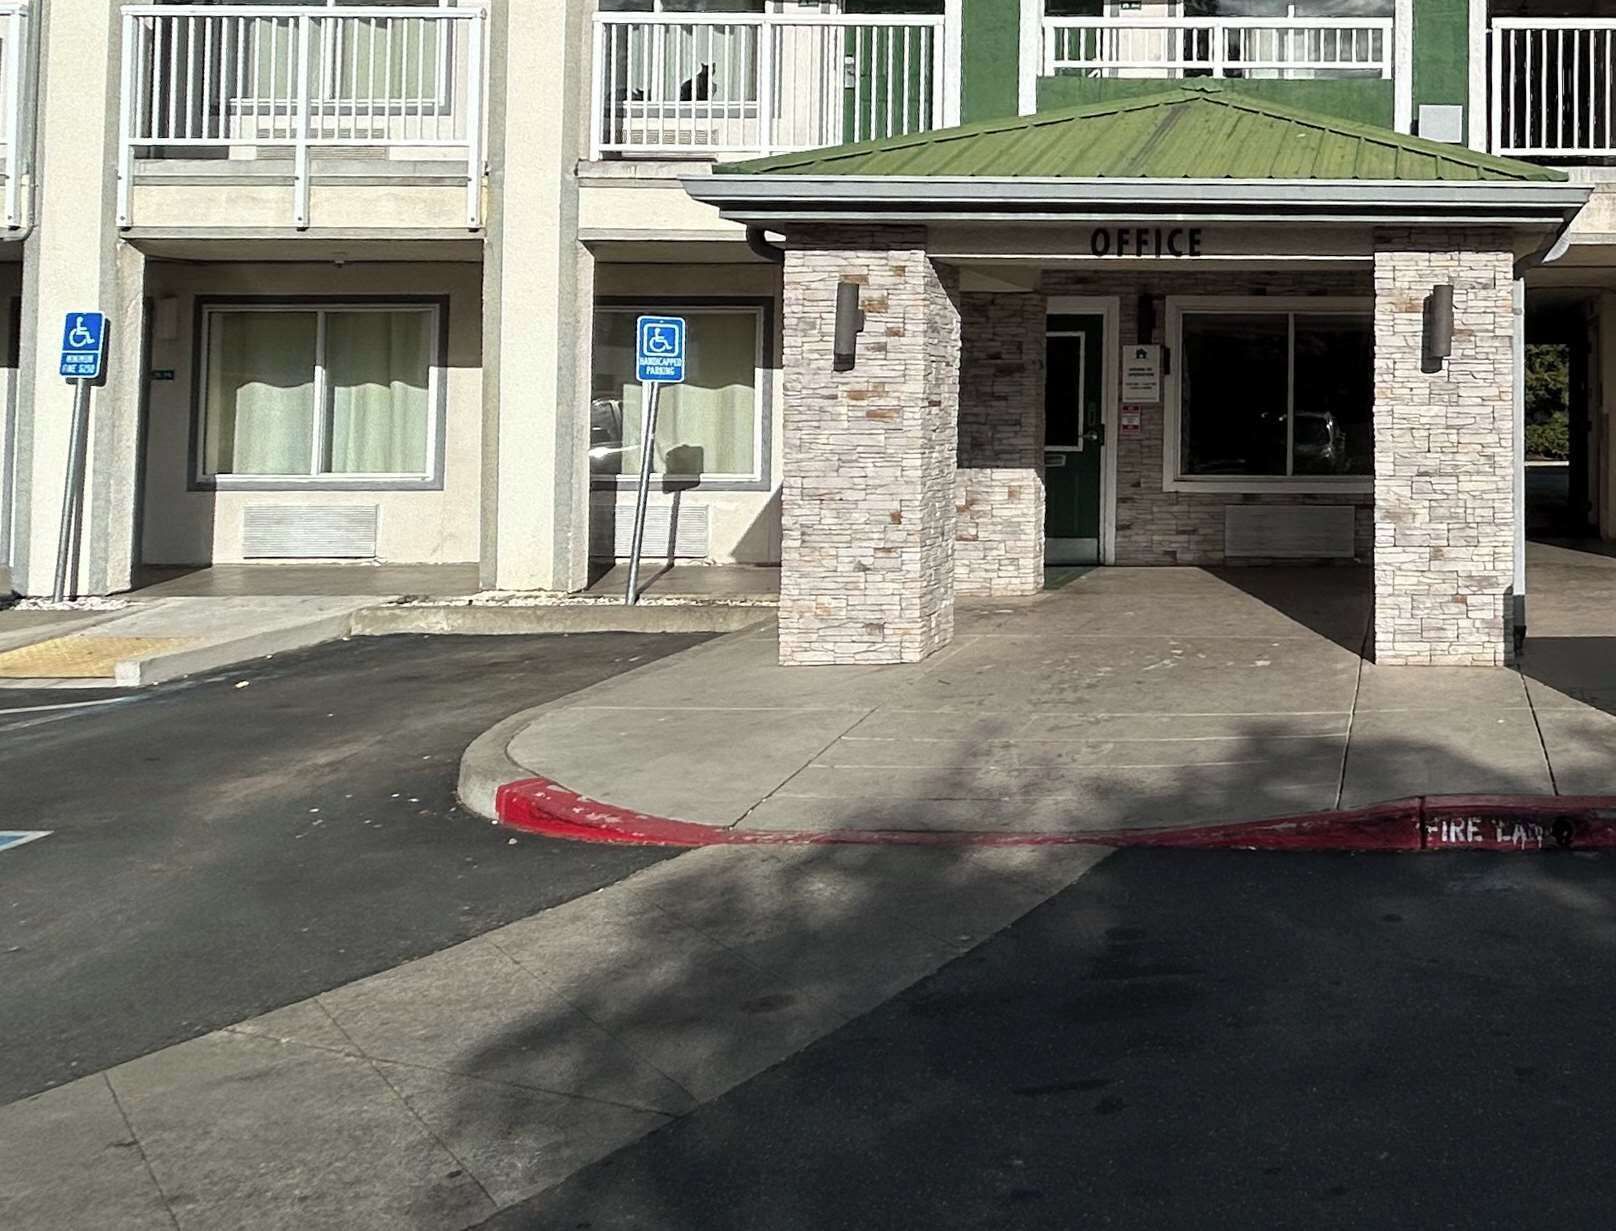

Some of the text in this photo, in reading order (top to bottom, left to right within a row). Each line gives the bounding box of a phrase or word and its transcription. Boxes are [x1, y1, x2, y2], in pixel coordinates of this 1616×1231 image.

[1090, 227, 1202, 258] OFFICE
[646, 366, 676, 377] PARKING
[1425, 816, 1483, 844] FIRE
